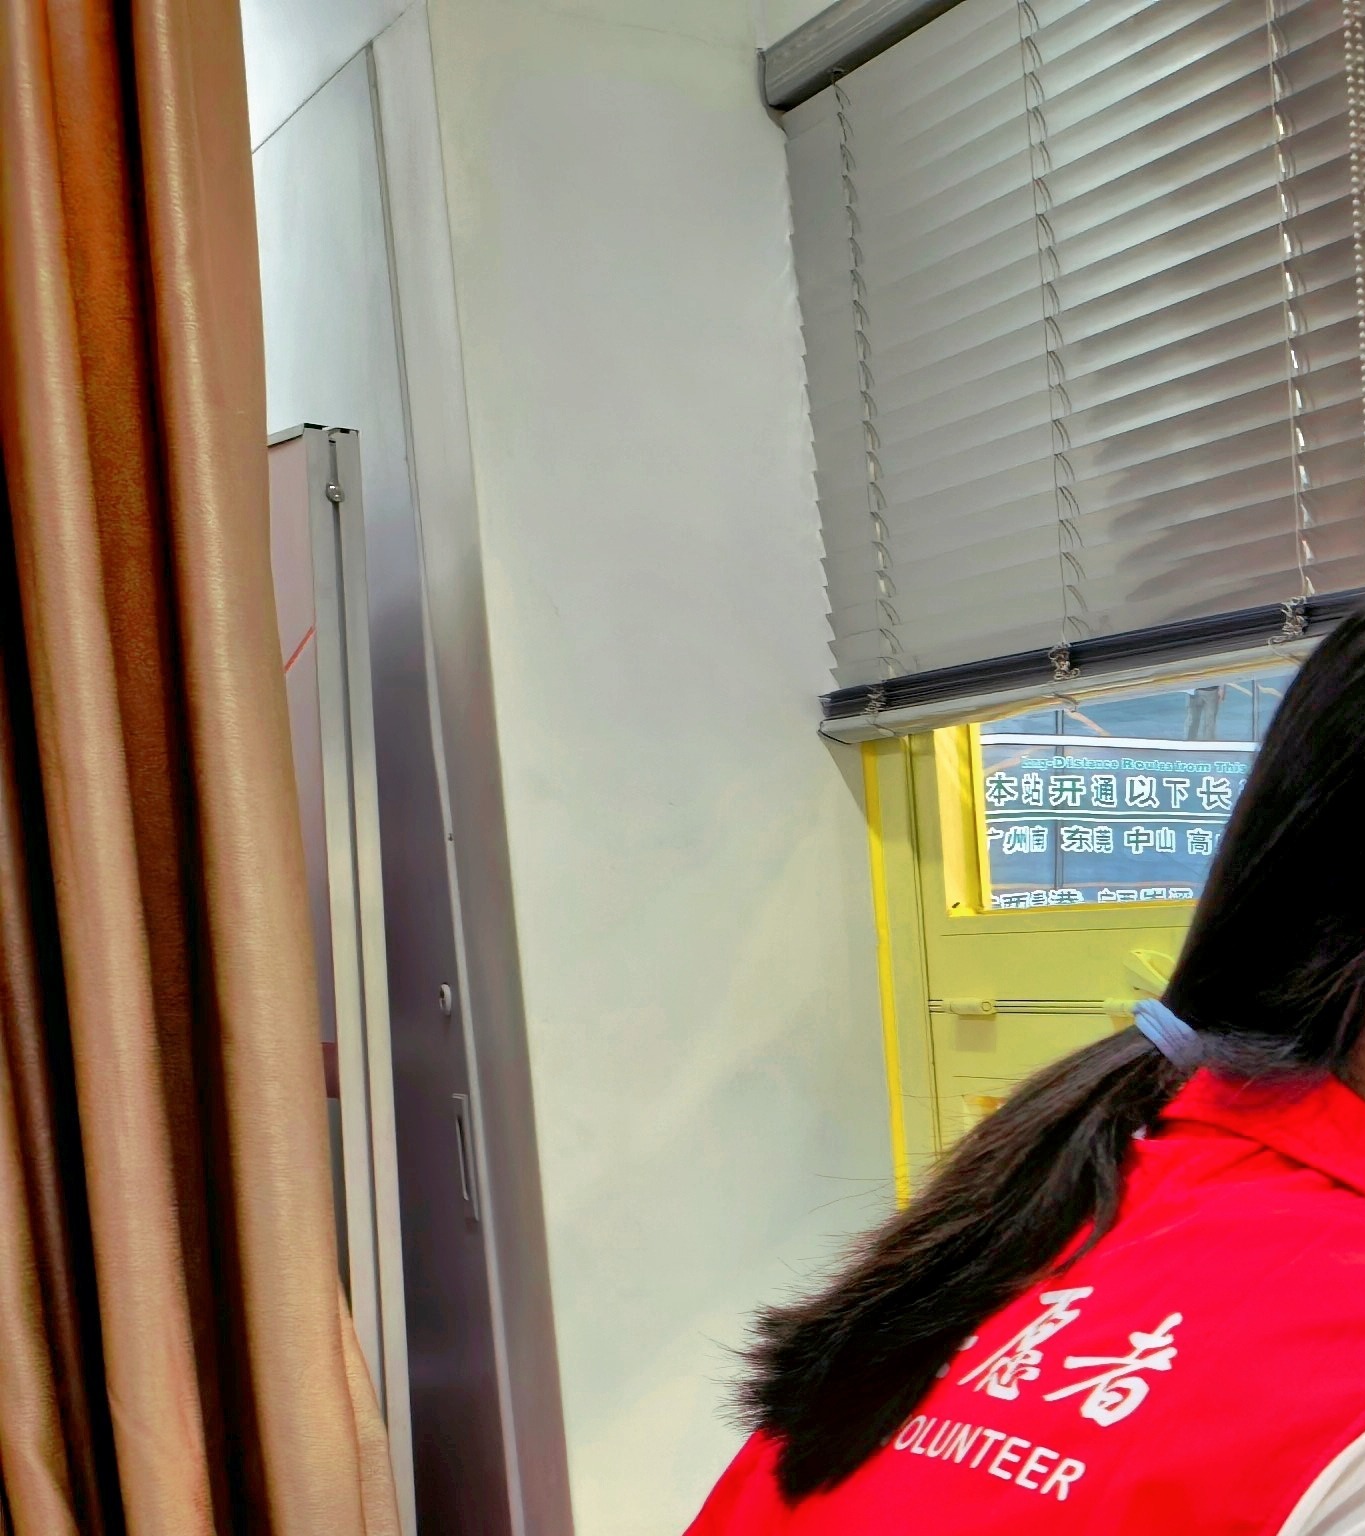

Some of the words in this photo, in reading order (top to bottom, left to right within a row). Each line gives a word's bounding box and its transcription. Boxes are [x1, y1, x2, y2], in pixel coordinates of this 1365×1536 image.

[986, 772, 1246, 811] 本站开通以下长
[1124, 826, 1176, 854] 中山
[1187, 828, 1221, 856] 高
[937, 1286, 1183, 1427] 愿者
[880, 1413, 1086, 1501] OLUNTEER
